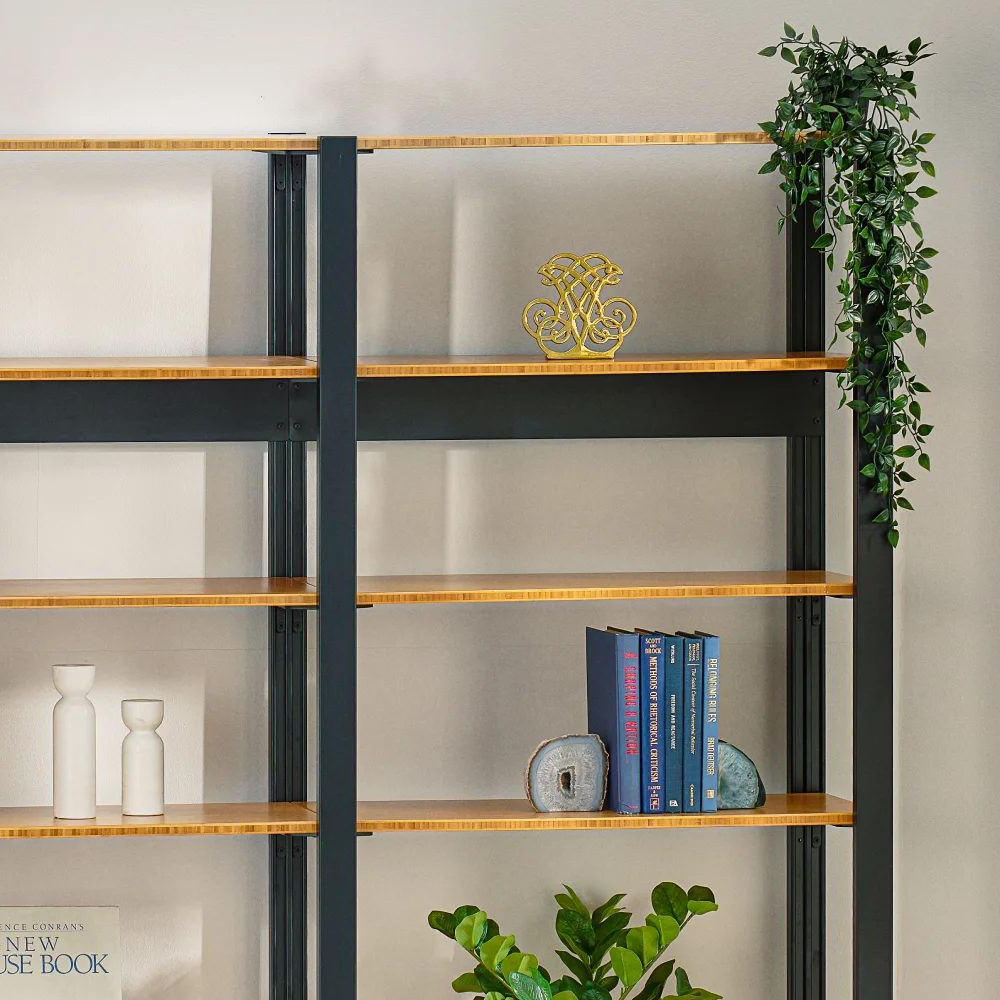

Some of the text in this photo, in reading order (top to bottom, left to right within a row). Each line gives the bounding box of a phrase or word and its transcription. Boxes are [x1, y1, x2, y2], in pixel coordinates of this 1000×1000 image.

[707, 658, 718, 723] BELONGING RULES
[649, 656, 659, 783] METHODS OF RHETORICAL CRITICISM
[32, 923, 85, 931] CONRAN'S
[5, 936, 59, 952] NEW
[39, 953, 109, 975] BOOK
